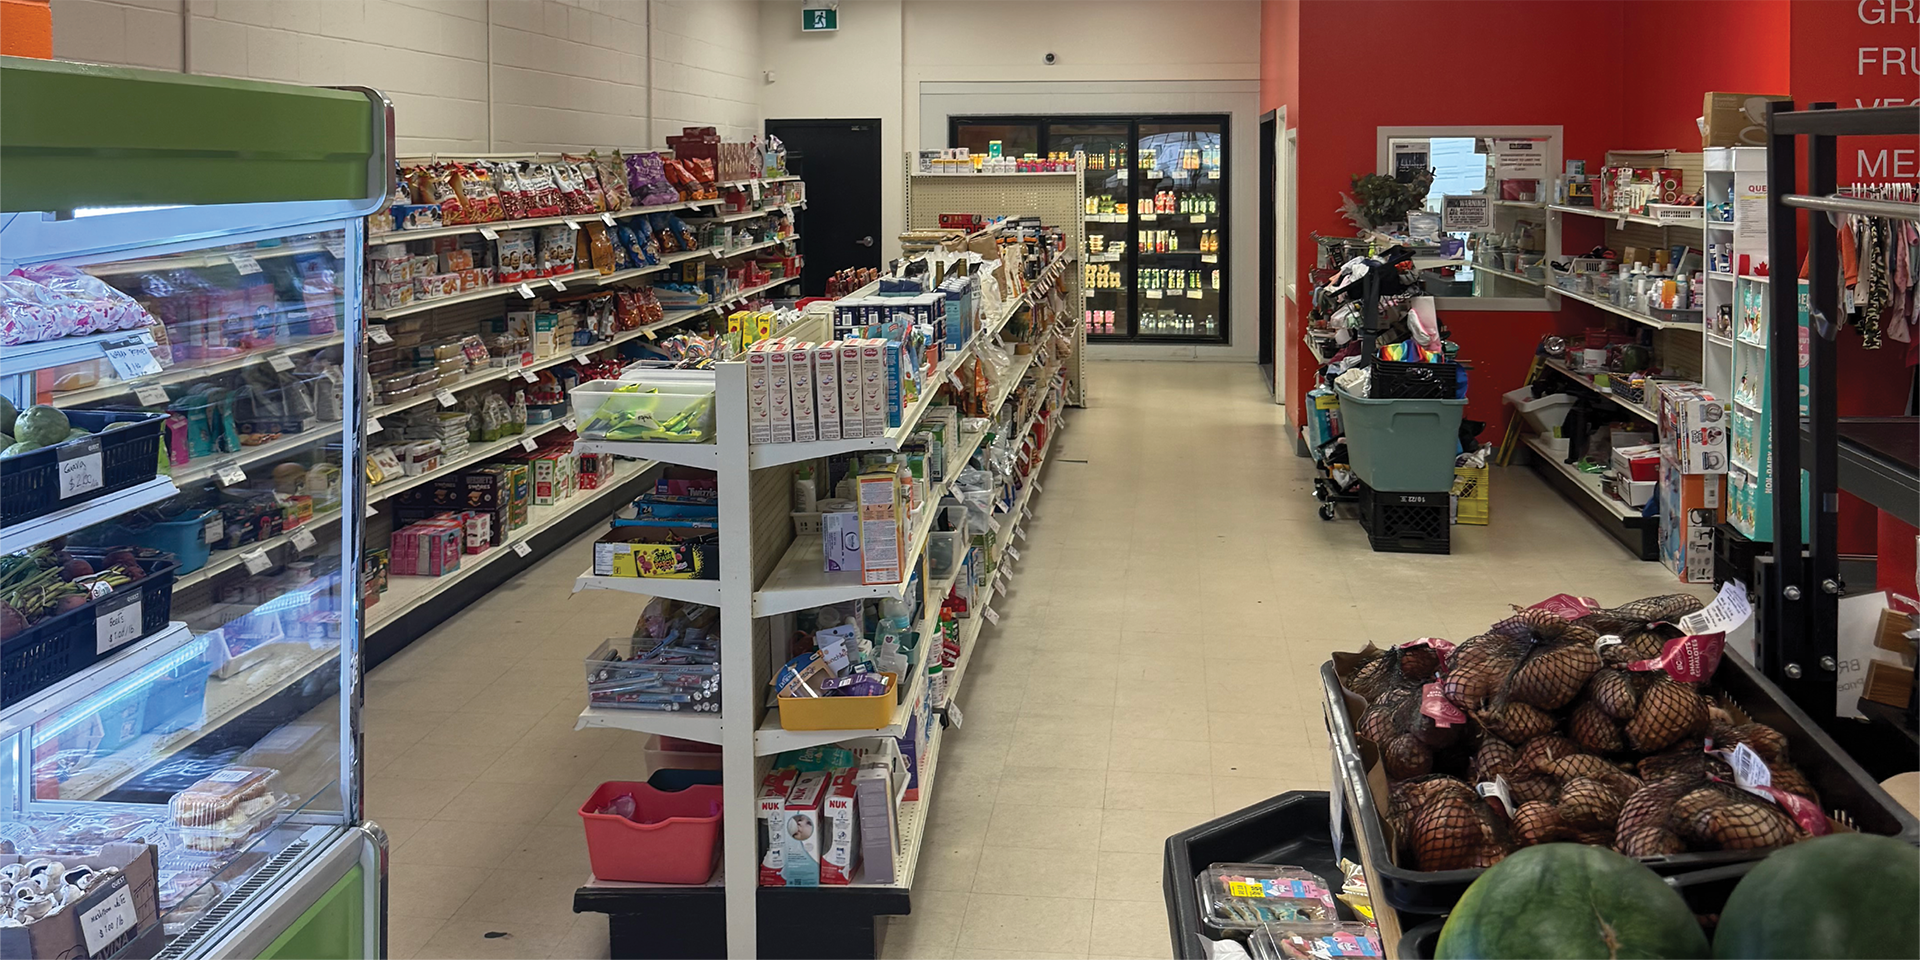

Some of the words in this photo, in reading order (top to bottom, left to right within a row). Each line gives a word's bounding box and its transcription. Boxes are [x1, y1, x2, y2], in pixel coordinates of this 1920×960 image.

[1858, 0, 1920, 24] GR
[1857, 149, 1920, 178] ME
[1748, 185, 1767, 193] QUE
[1460, 199, 1486, 207] WARNING
[688, 487, 718, 497] Twizzle
[1685, 641, 1695, 676] SHALLOTS
[761, 802, 780, 811] NUK
[829, 800, 848, 809] NUK
